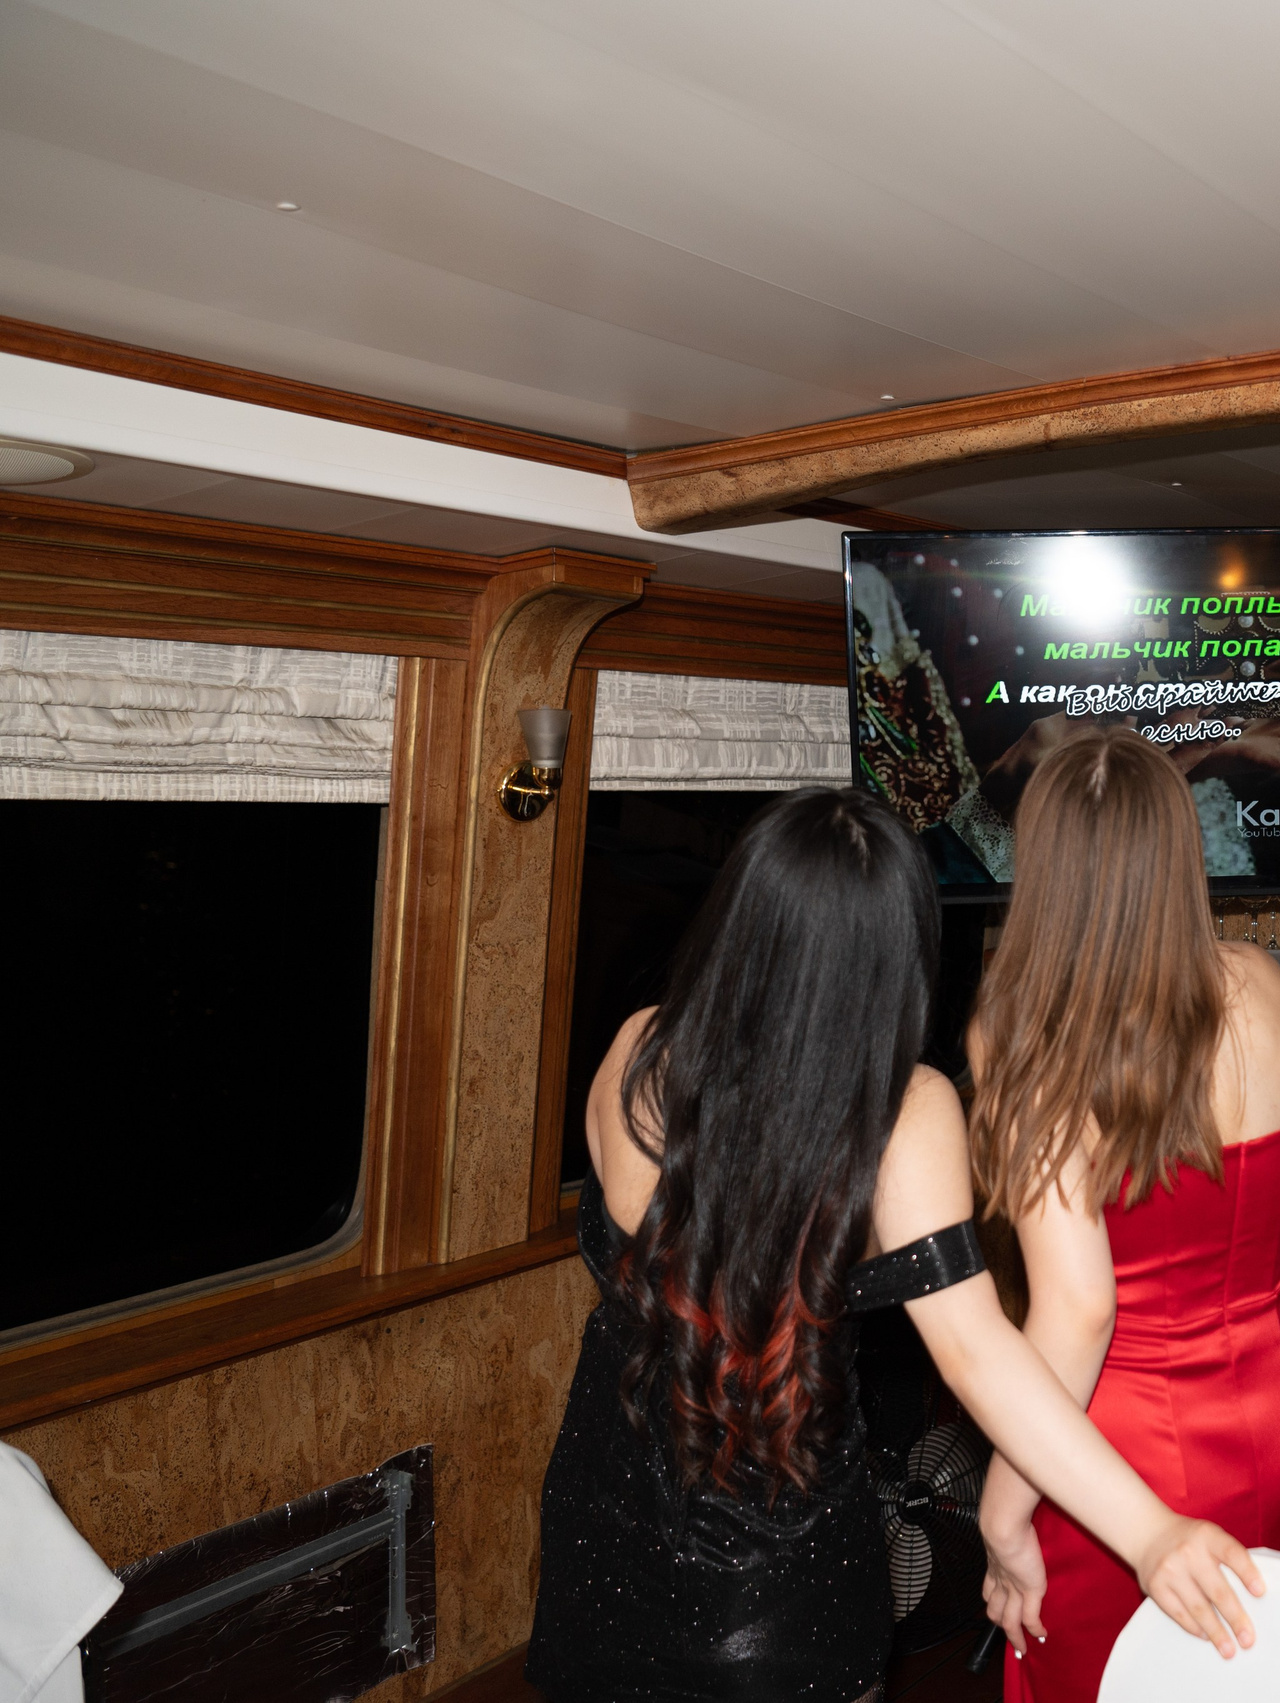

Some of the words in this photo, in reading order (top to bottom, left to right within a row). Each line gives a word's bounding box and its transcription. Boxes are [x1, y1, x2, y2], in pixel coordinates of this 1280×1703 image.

[1020, 594, 1171, 617] Маик
[1044, 637, 1190, 660] мальчик
[986, 681, 1009, 704] А
[1020, 684, 1078, 704] как
[1066, 680, 1280, 716] Выбирайте
[1130, 720, 1242, 743] есню..
